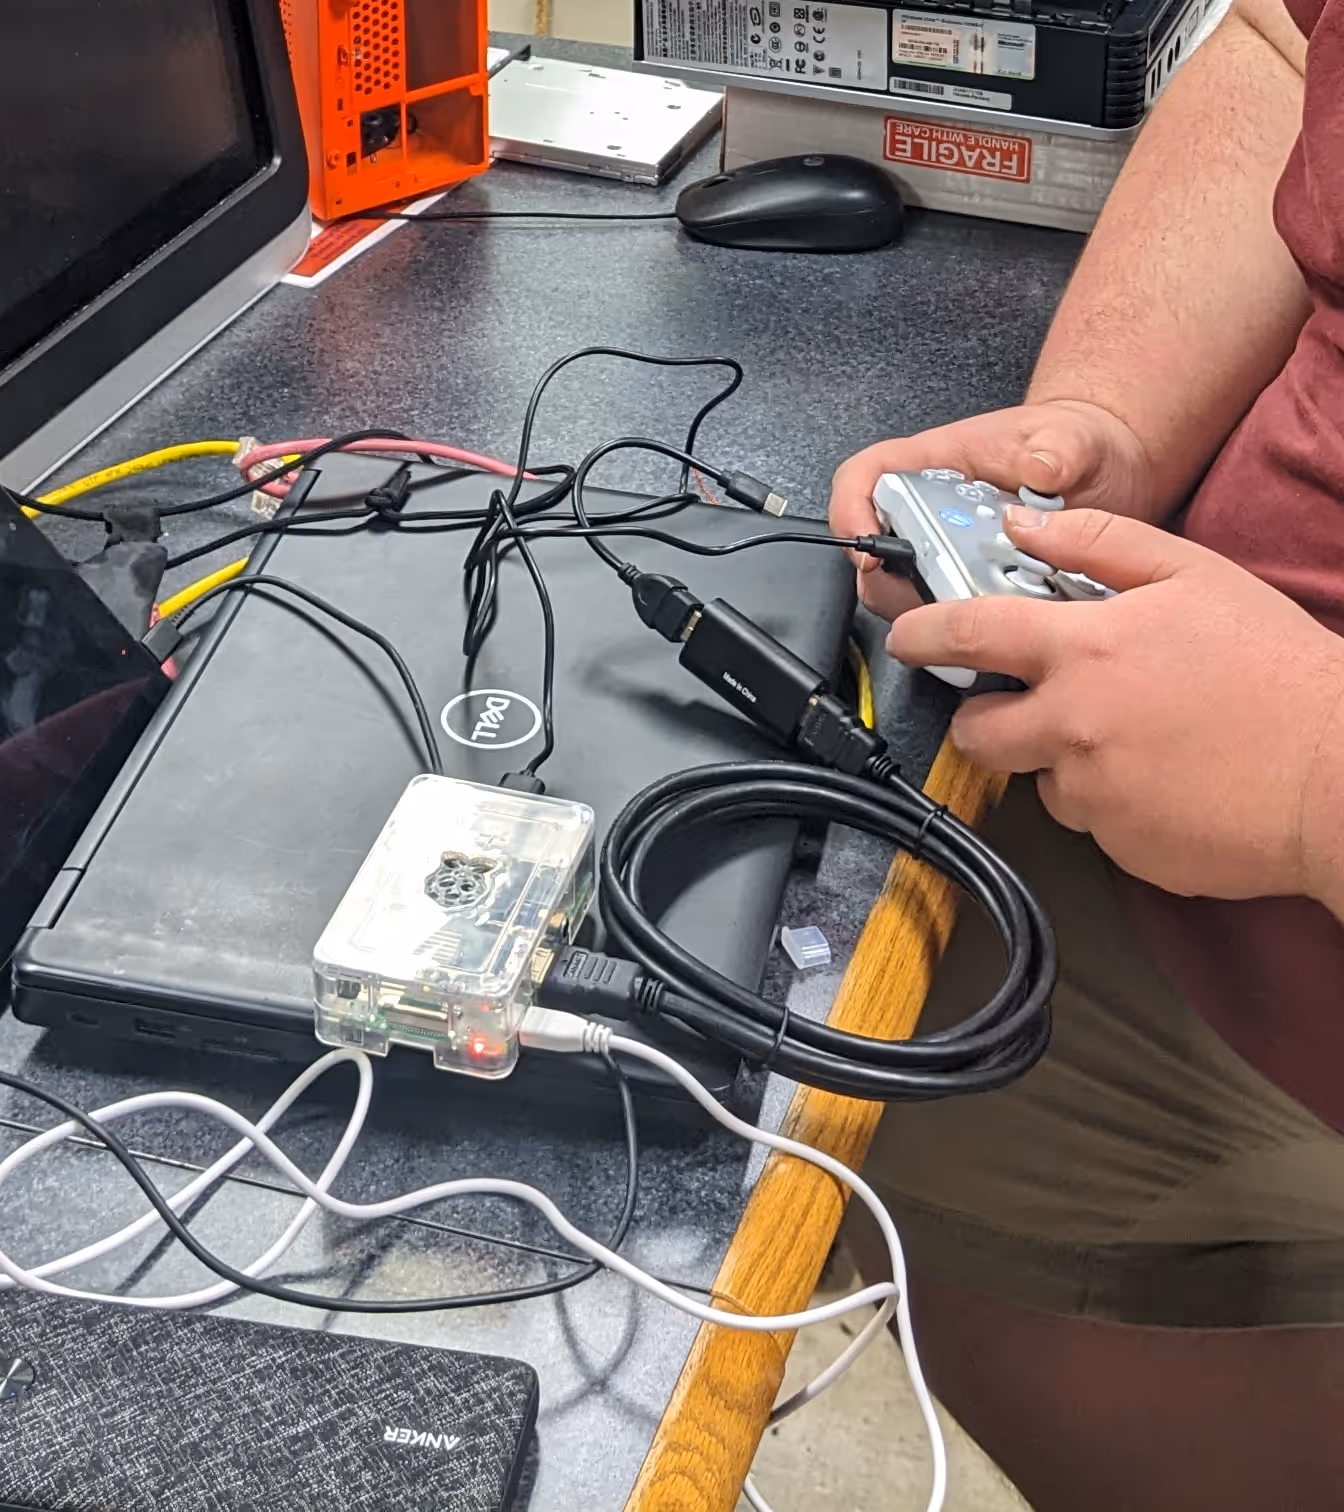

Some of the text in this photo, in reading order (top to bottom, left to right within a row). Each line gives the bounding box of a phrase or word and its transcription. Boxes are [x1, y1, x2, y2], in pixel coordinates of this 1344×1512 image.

[896, 122, 1019, 151] HANDLE WITH CARE
[895, 134, 1018, 175] FRAGILE
[470, 696, 511, 741] DELL
[383, 1425, 461, 1450] ANKER
